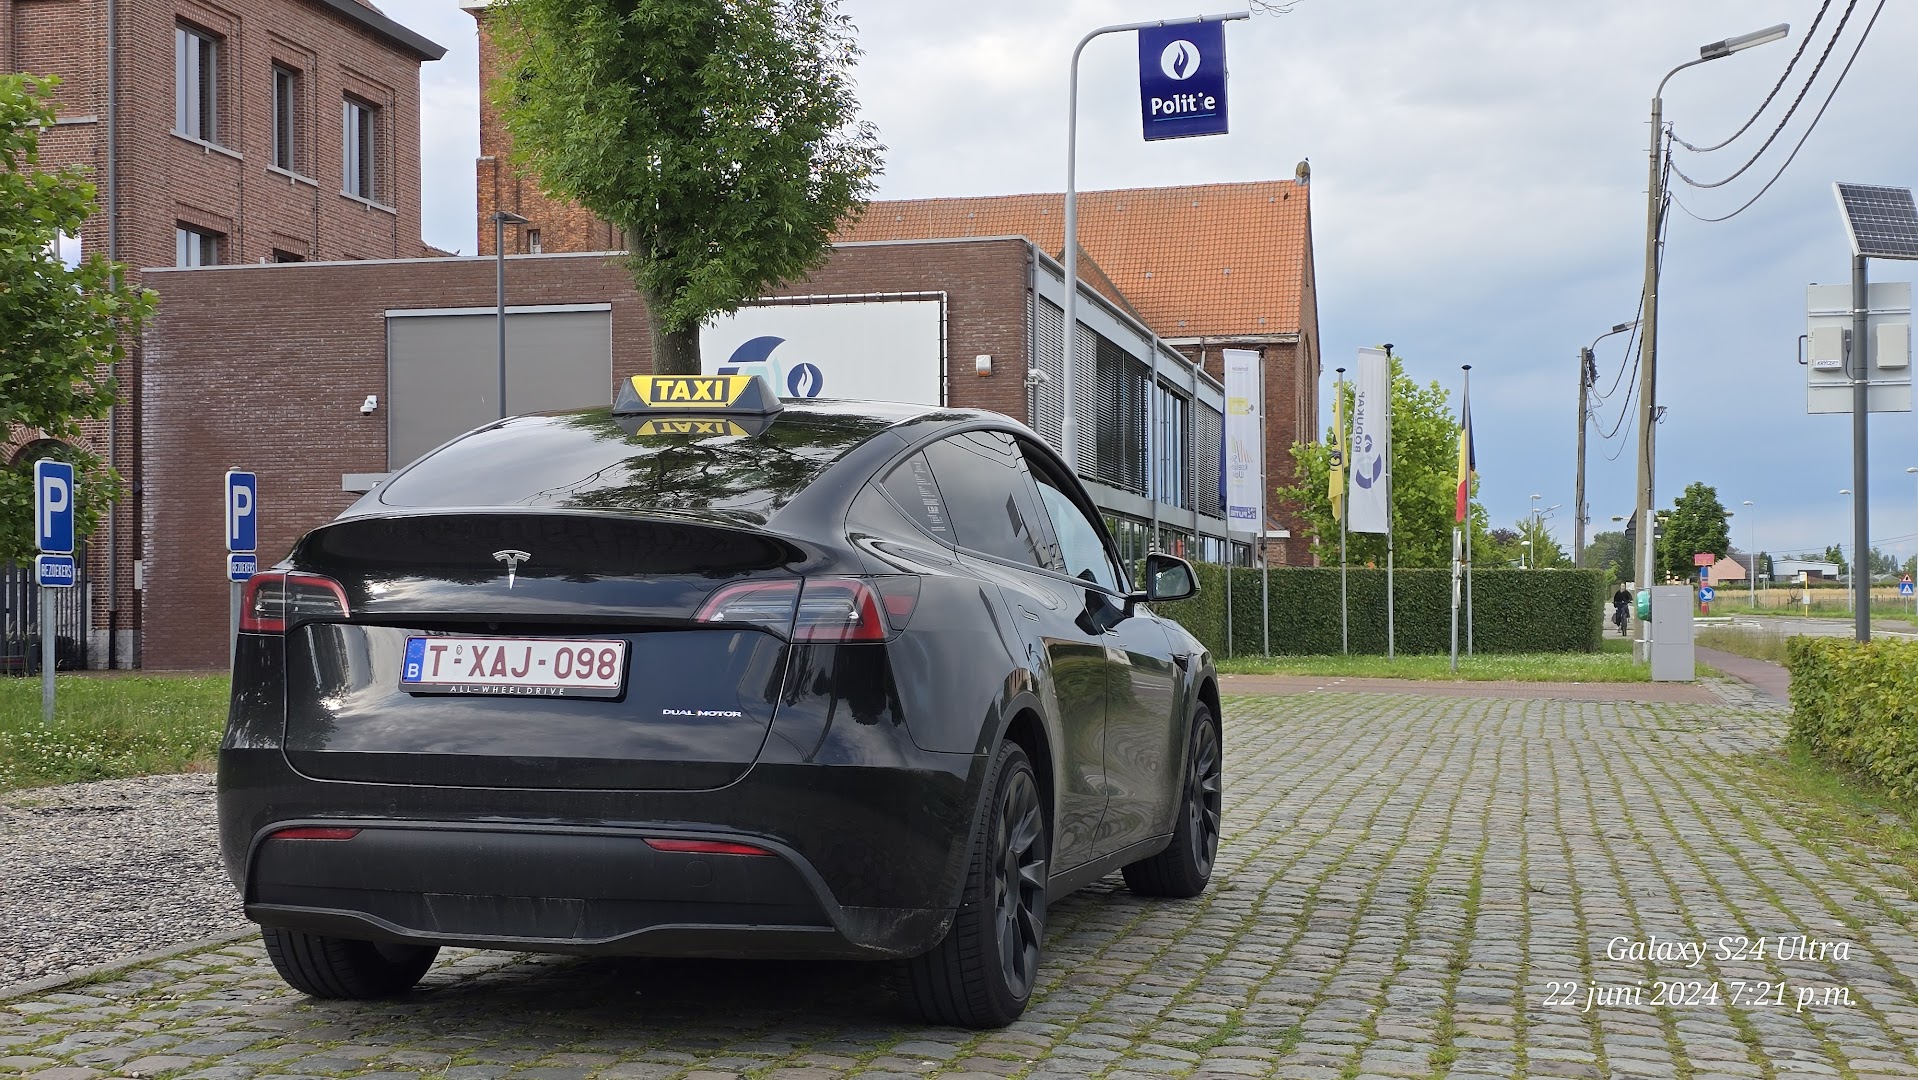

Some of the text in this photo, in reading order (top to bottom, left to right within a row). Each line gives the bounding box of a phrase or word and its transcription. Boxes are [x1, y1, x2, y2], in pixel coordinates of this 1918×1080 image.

[656, 380, 723, 400] TAXI
[43, 476, 69, 538] P
[232, 485, 253, 539] P
[41, 563, 72, 578] BEZOEKERS
[407, 663, 420, 678] B
[526, 686, 565, 696] DRIVE
[697, 710, 742, 718] MOTOR
